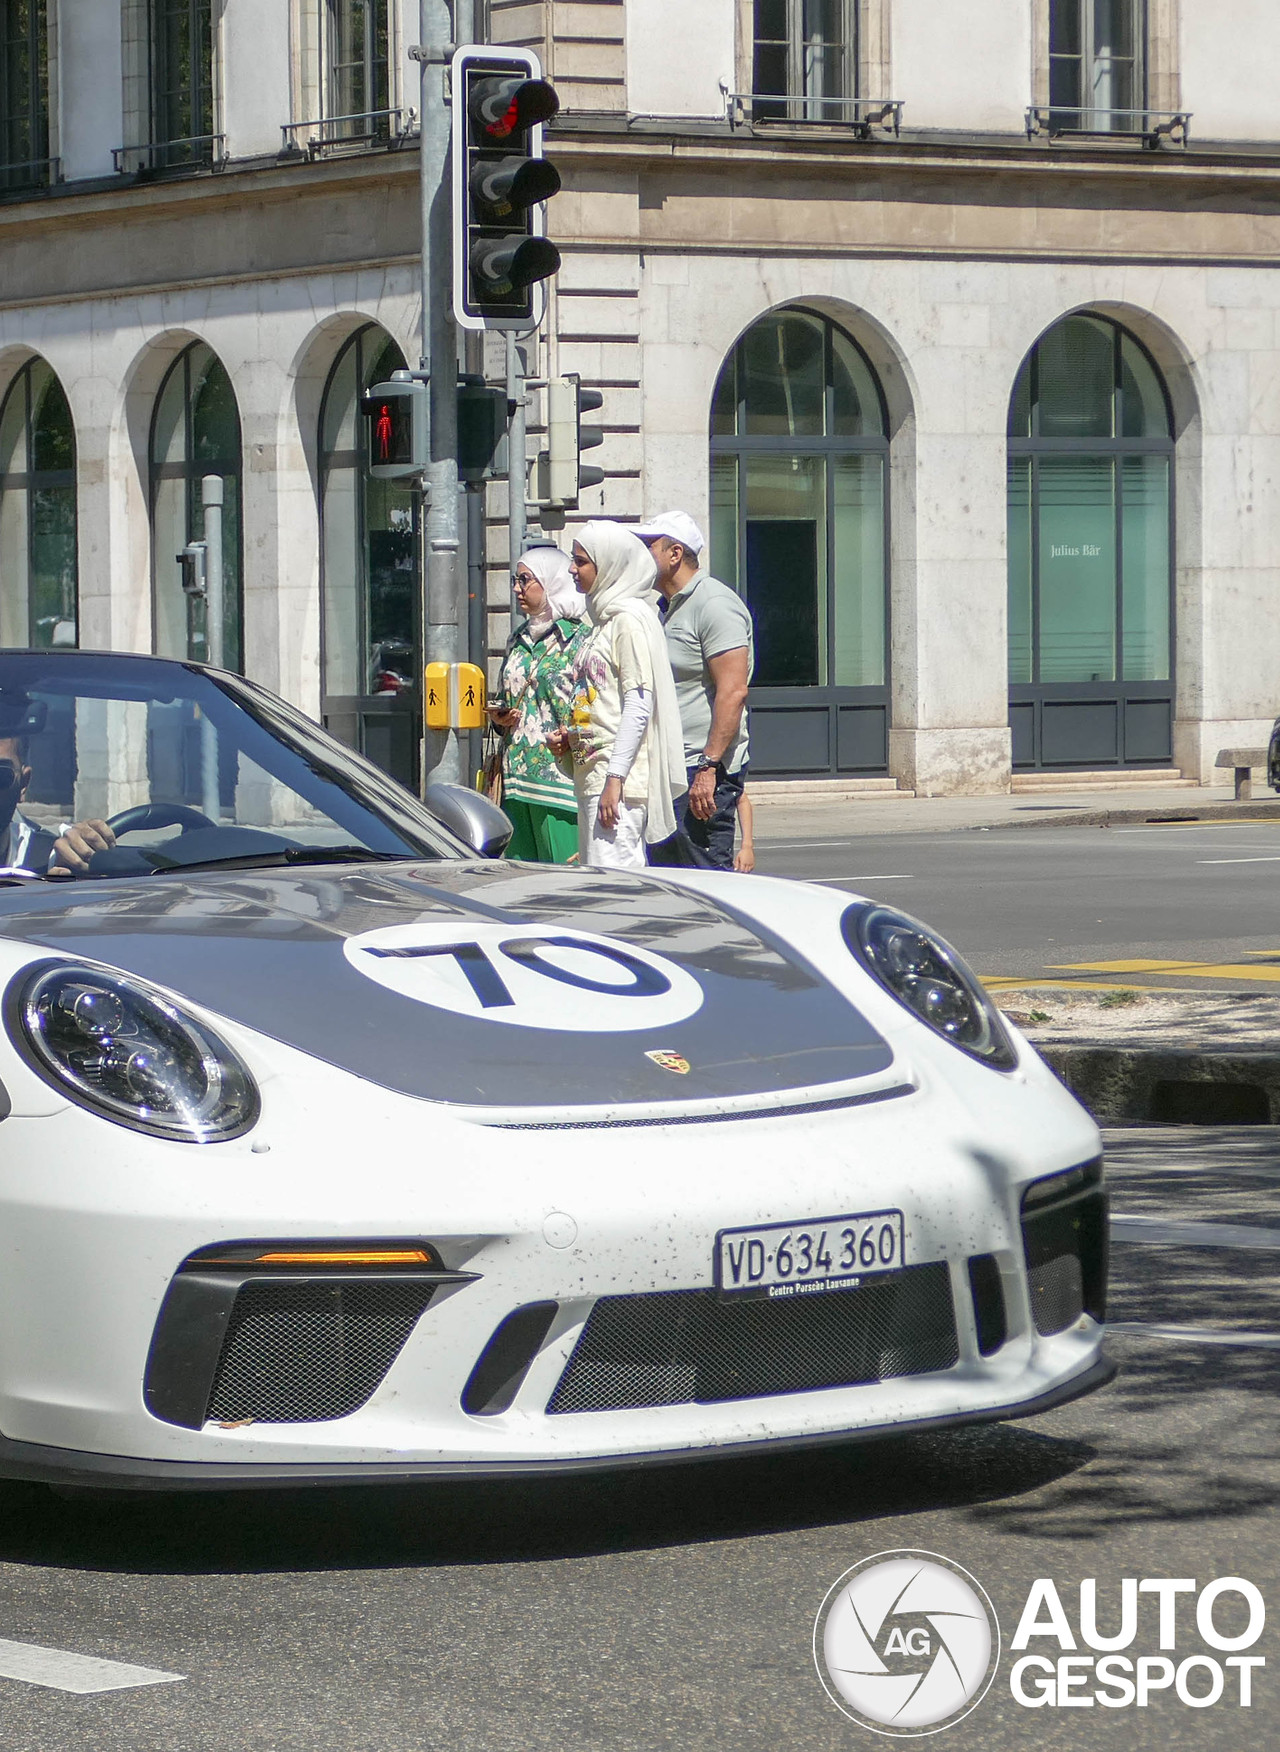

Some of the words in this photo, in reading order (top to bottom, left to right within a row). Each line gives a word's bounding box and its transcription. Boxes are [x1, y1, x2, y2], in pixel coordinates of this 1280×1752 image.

[1051, 544, 1080, 558] Julius
[1082, 544, 1101, 556] Bär
[360, 936, 672, 1009] 70
[769, 1285, 794, 1297] Centre
[795, 1280, 824, 1293] Porsche
[826, 1277, 860, 1290] Lausanne
